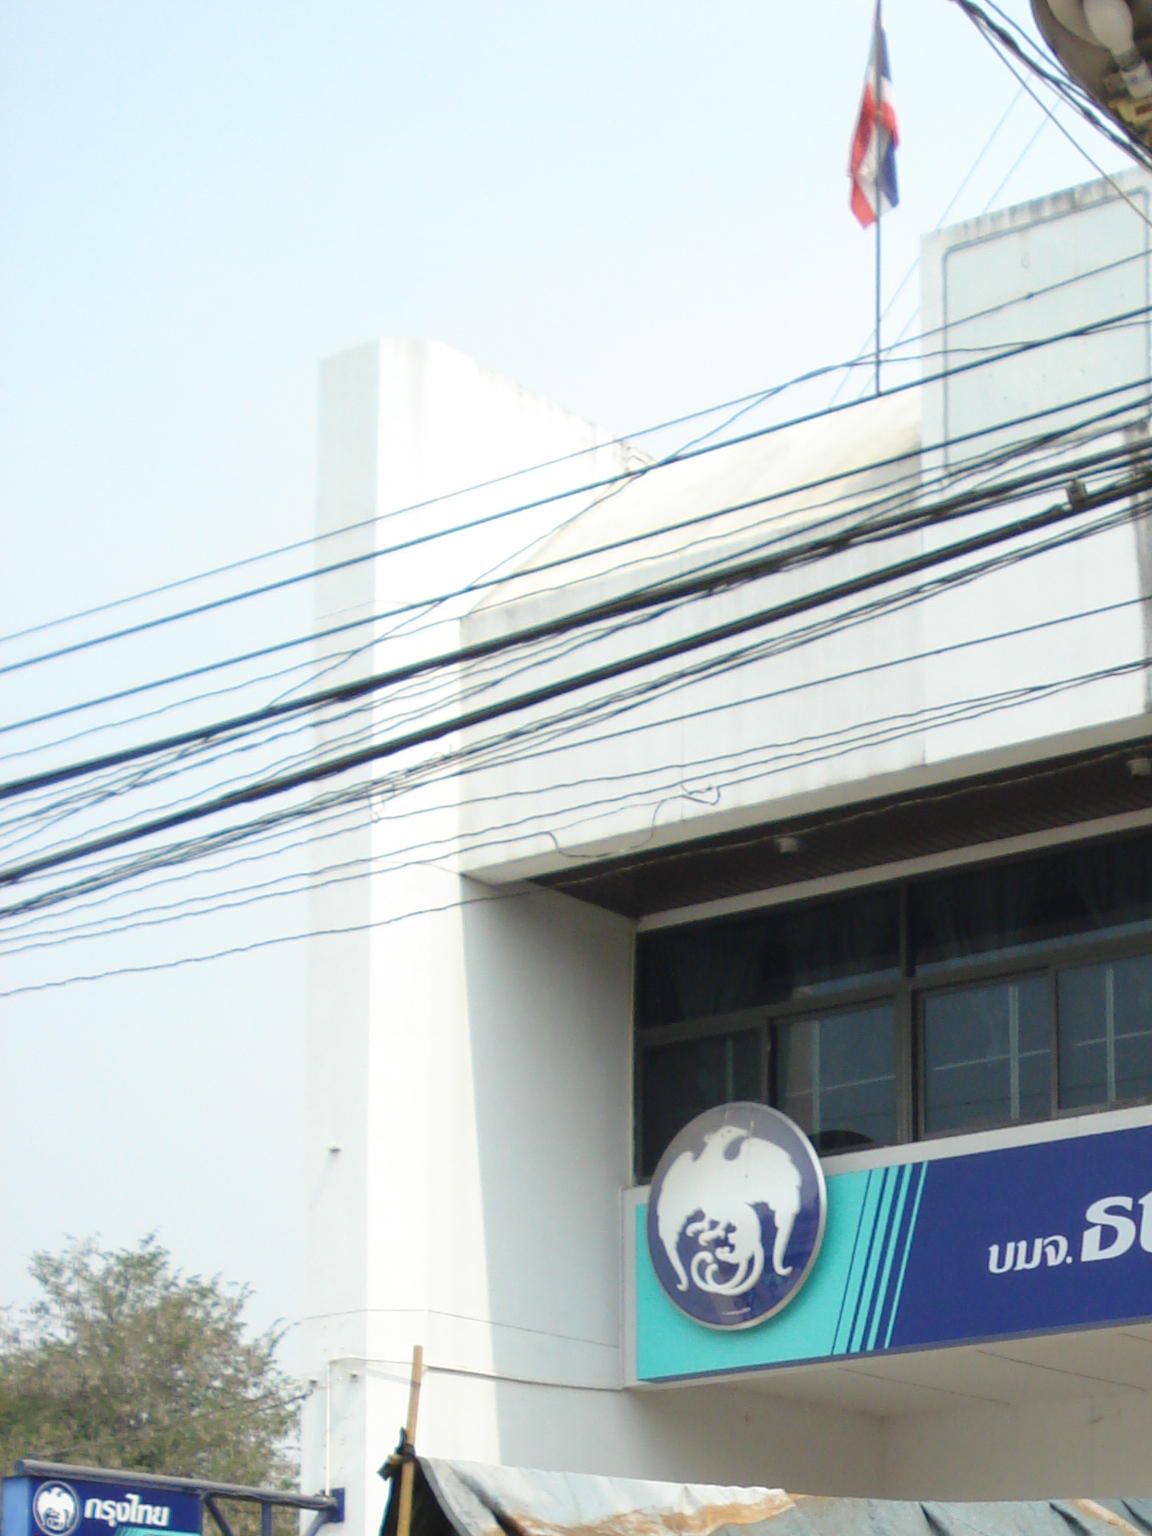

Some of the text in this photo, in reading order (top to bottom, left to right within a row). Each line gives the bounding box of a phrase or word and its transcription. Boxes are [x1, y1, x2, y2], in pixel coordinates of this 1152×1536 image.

[987, 1231, 1073, 1275] บมจ.
[83, 1493, 171, 1528] กรุงไทย
